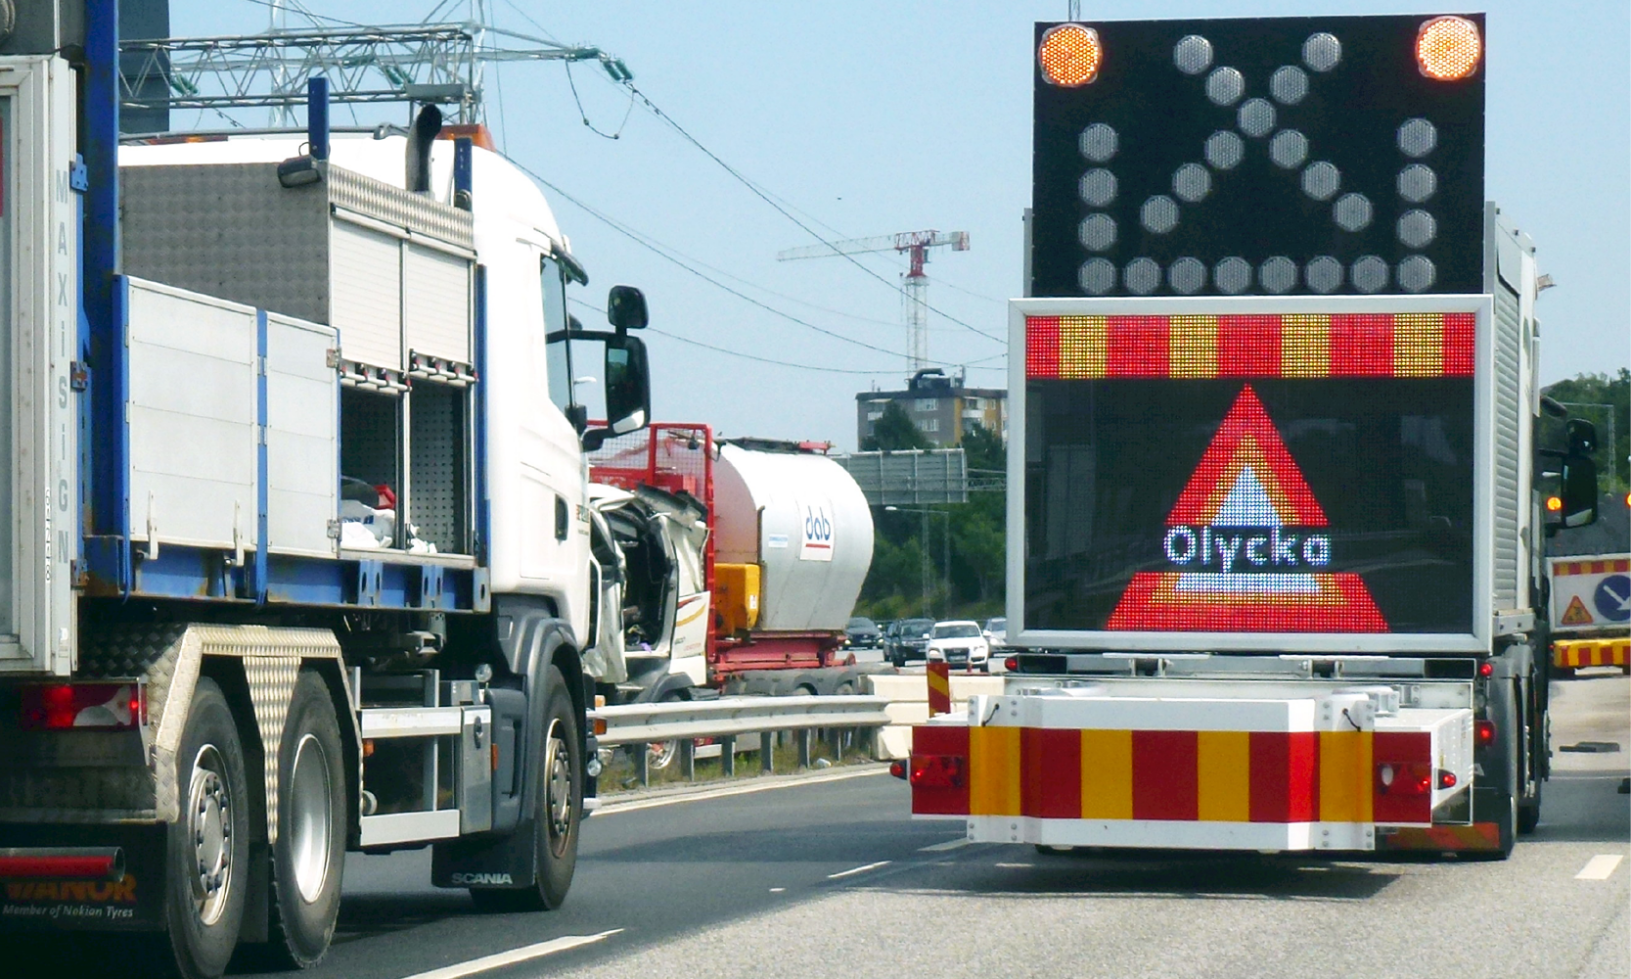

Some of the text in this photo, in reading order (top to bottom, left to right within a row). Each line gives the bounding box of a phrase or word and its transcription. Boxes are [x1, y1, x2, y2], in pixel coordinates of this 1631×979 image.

[805, 505, 831, 541] dab
[1163, 525, 1332, 573] Olycka
[451, 872, 513, 884] SCANIA
[3, 904, 134, 919] Member of Nokian Tyres
